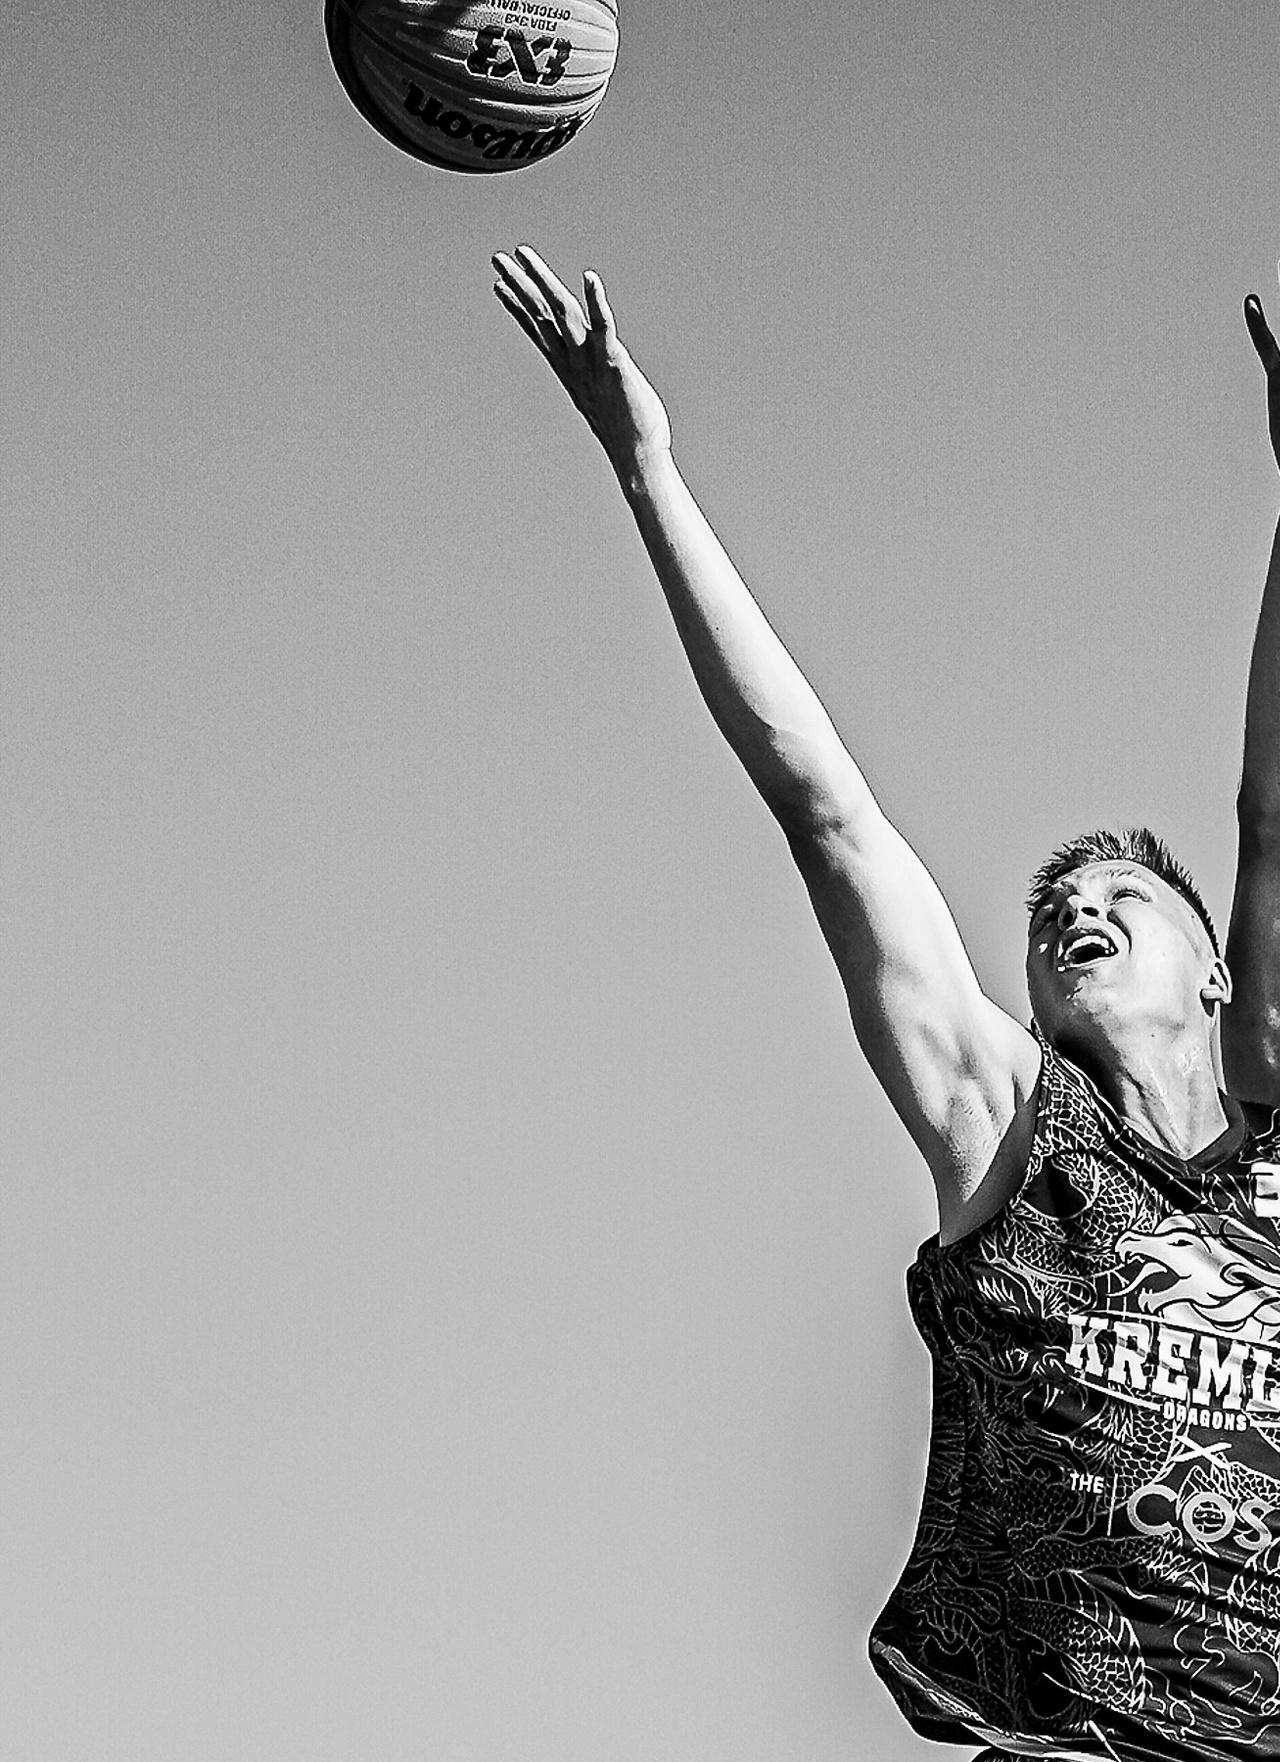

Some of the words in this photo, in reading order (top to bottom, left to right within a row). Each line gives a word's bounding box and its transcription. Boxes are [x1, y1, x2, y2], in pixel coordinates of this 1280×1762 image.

[521, 2, 571, 20] OFFICIAL
[1163, 1401, 1247, 1431] DRAGONS
[1069, 1473, 1104, 1494] THE
